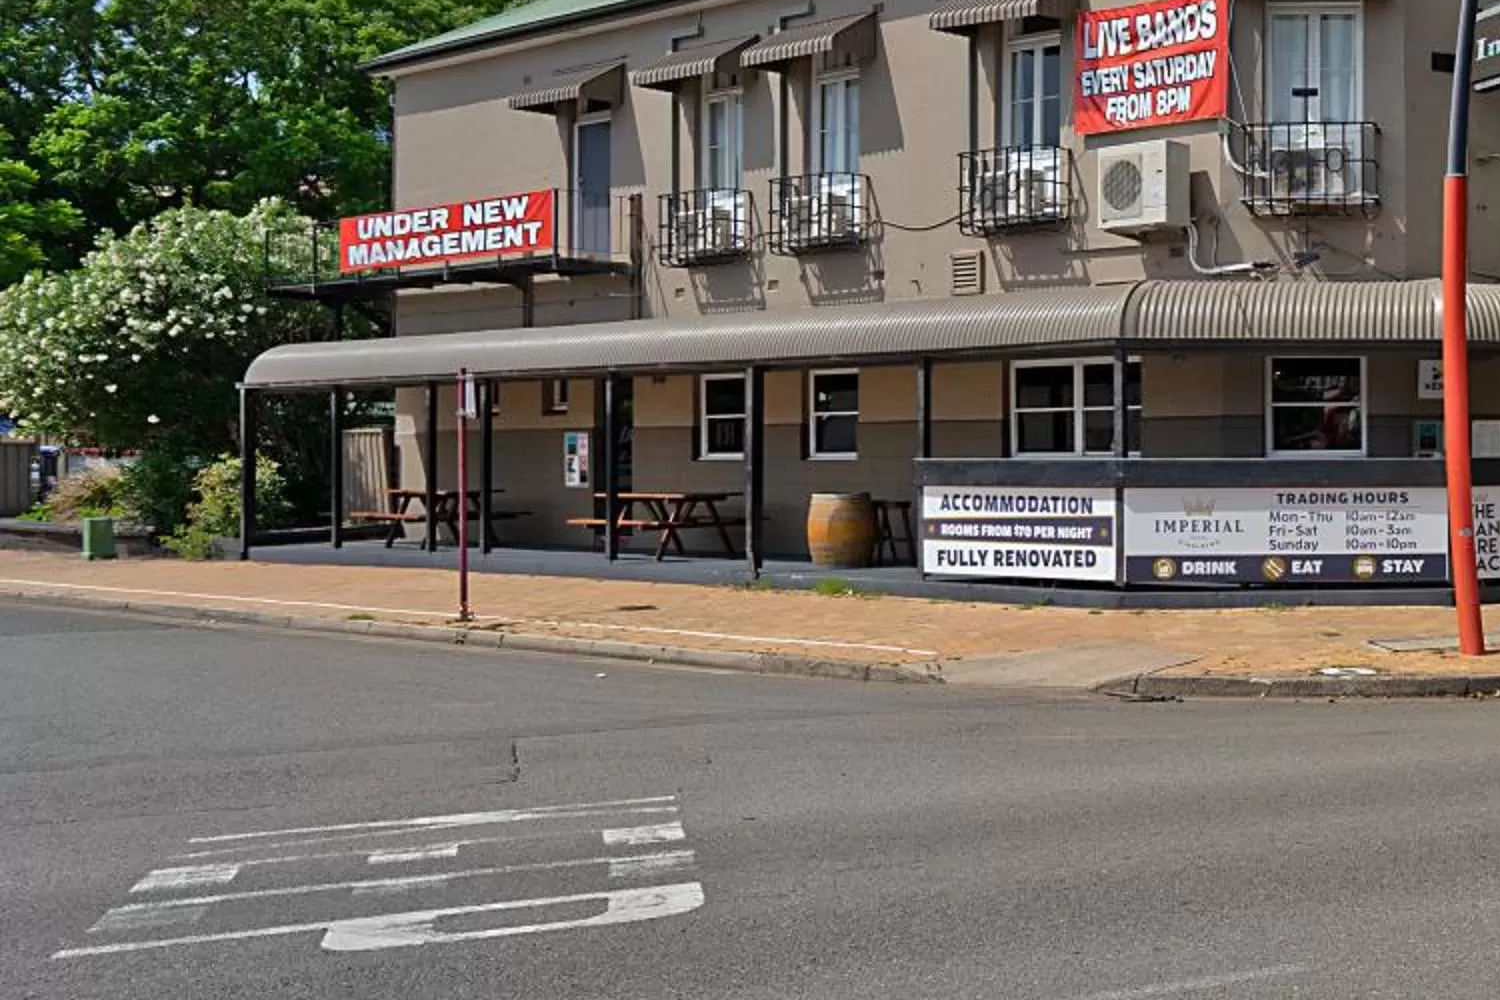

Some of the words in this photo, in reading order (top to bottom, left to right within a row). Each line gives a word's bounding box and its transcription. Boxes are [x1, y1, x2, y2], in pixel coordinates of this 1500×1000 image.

[1083, 17, 1132, 59] LIVE
[1136, 0, 1217, 51] BANDS
[1081, 65, 1129, 97] EVERY
[1133, 50, 1217, 89] SATURDAY
[1106, 91, 1152, 123] FROM
[1156, 86, 1192, 116] 8PM
[357, 208, 449, 239] UNDER
[463, 196, 529, 226] NEW
[348, 222, 542, 266] MANAGEMENT
[941, 494, 1093, 514] ACCOMMODATION
[1275, 492, 1348, 504] TRADING
[1353, 492, 1409, 504] HOURS
[1473, 504, 1495, 519] HE
[941, 524, 980, 536] ROOMS
[982, 525, 1012, 537] FROM
[1033, 525, 1055, 539] PER
[1057, 527, 1093, 539] NIGHT
[1155, 520, 1245, 533] IMPERIAL
[1269, 539, 1319, 552] Sunday
[1477, 537, 1497, 554] RE
[937, 549, 988, 567] FULLY
[993, 549, 1097, 568] RENOVATED
[1382, 559, 1425, 573] STAY
[1181, 561, 1237, 575] DRINK
[1291, 560, 1323, 574] EAT
